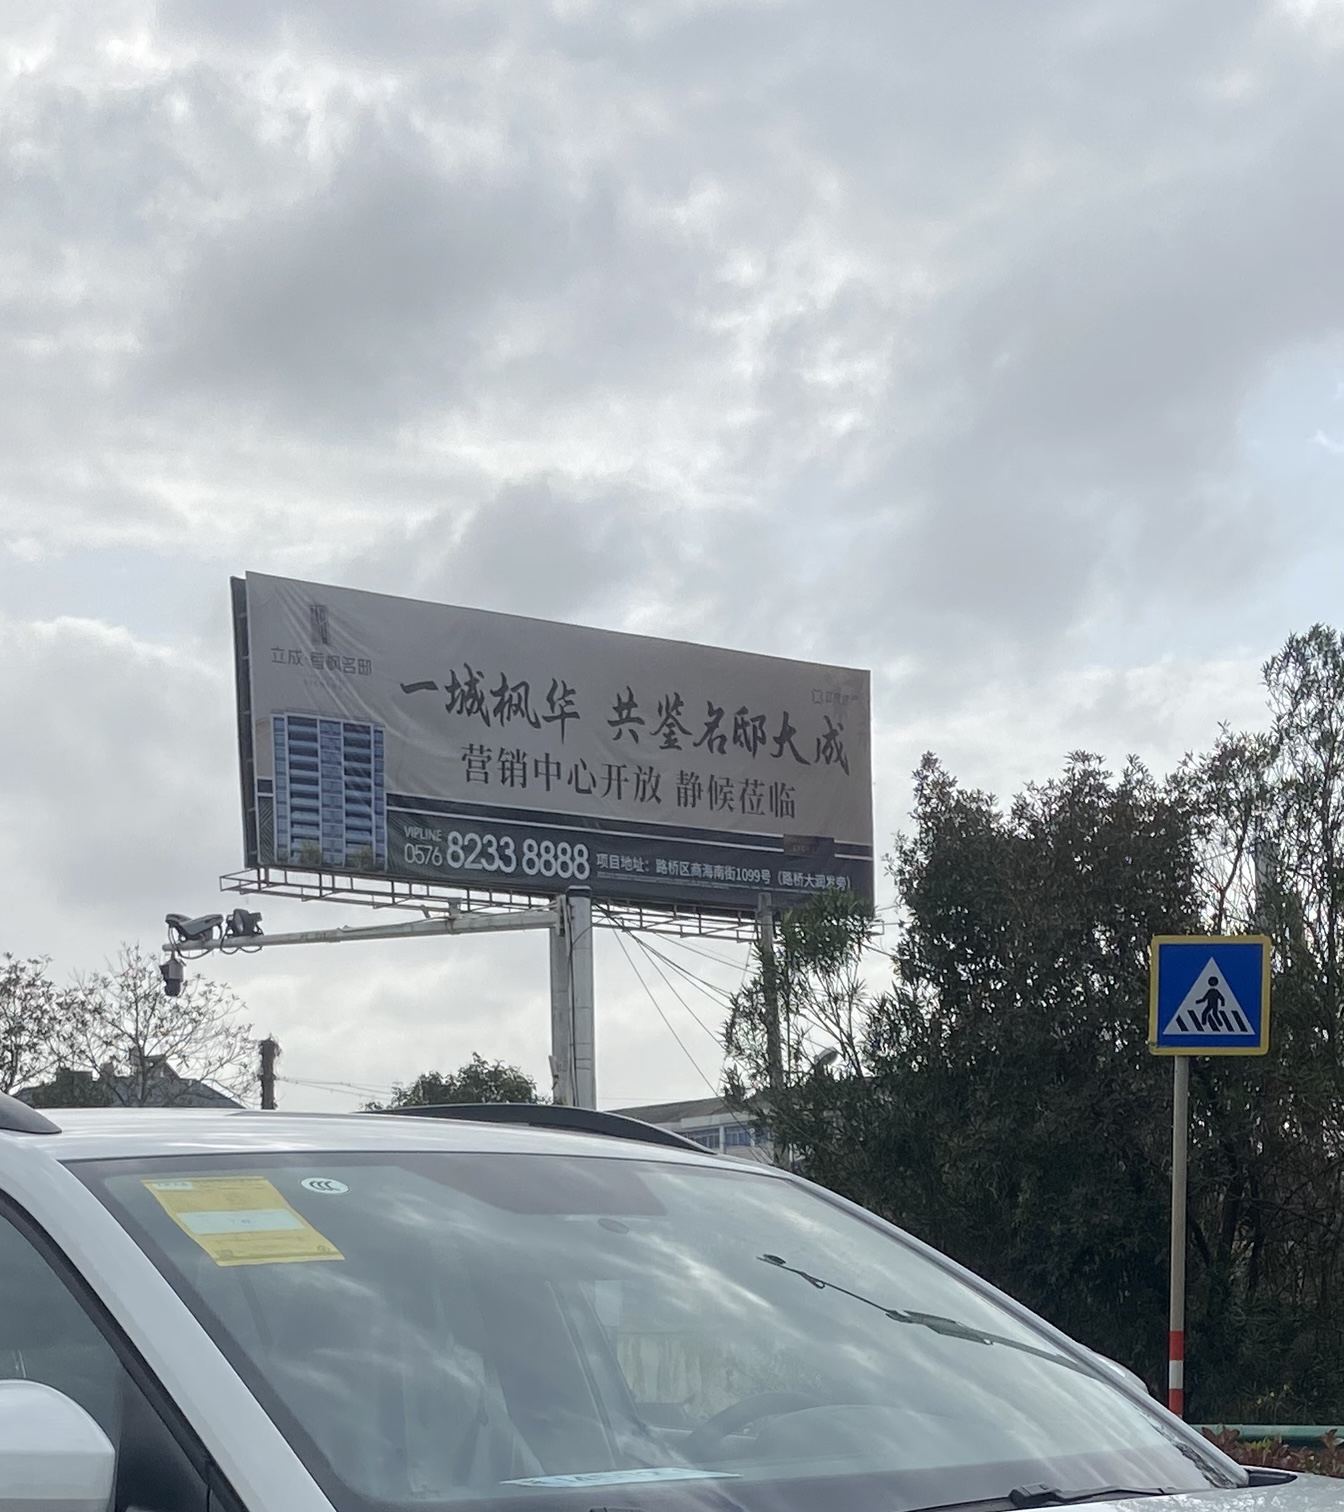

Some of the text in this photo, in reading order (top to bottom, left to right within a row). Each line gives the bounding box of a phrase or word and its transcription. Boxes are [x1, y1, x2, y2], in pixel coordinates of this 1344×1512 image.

[399, 662, 850, 777] 一城枫华 共鉴名邸大成
[460, 743, 797, 819] 营销中心开放 静候莅临
[404, 831, 591, 880] 0576 8233 8888
